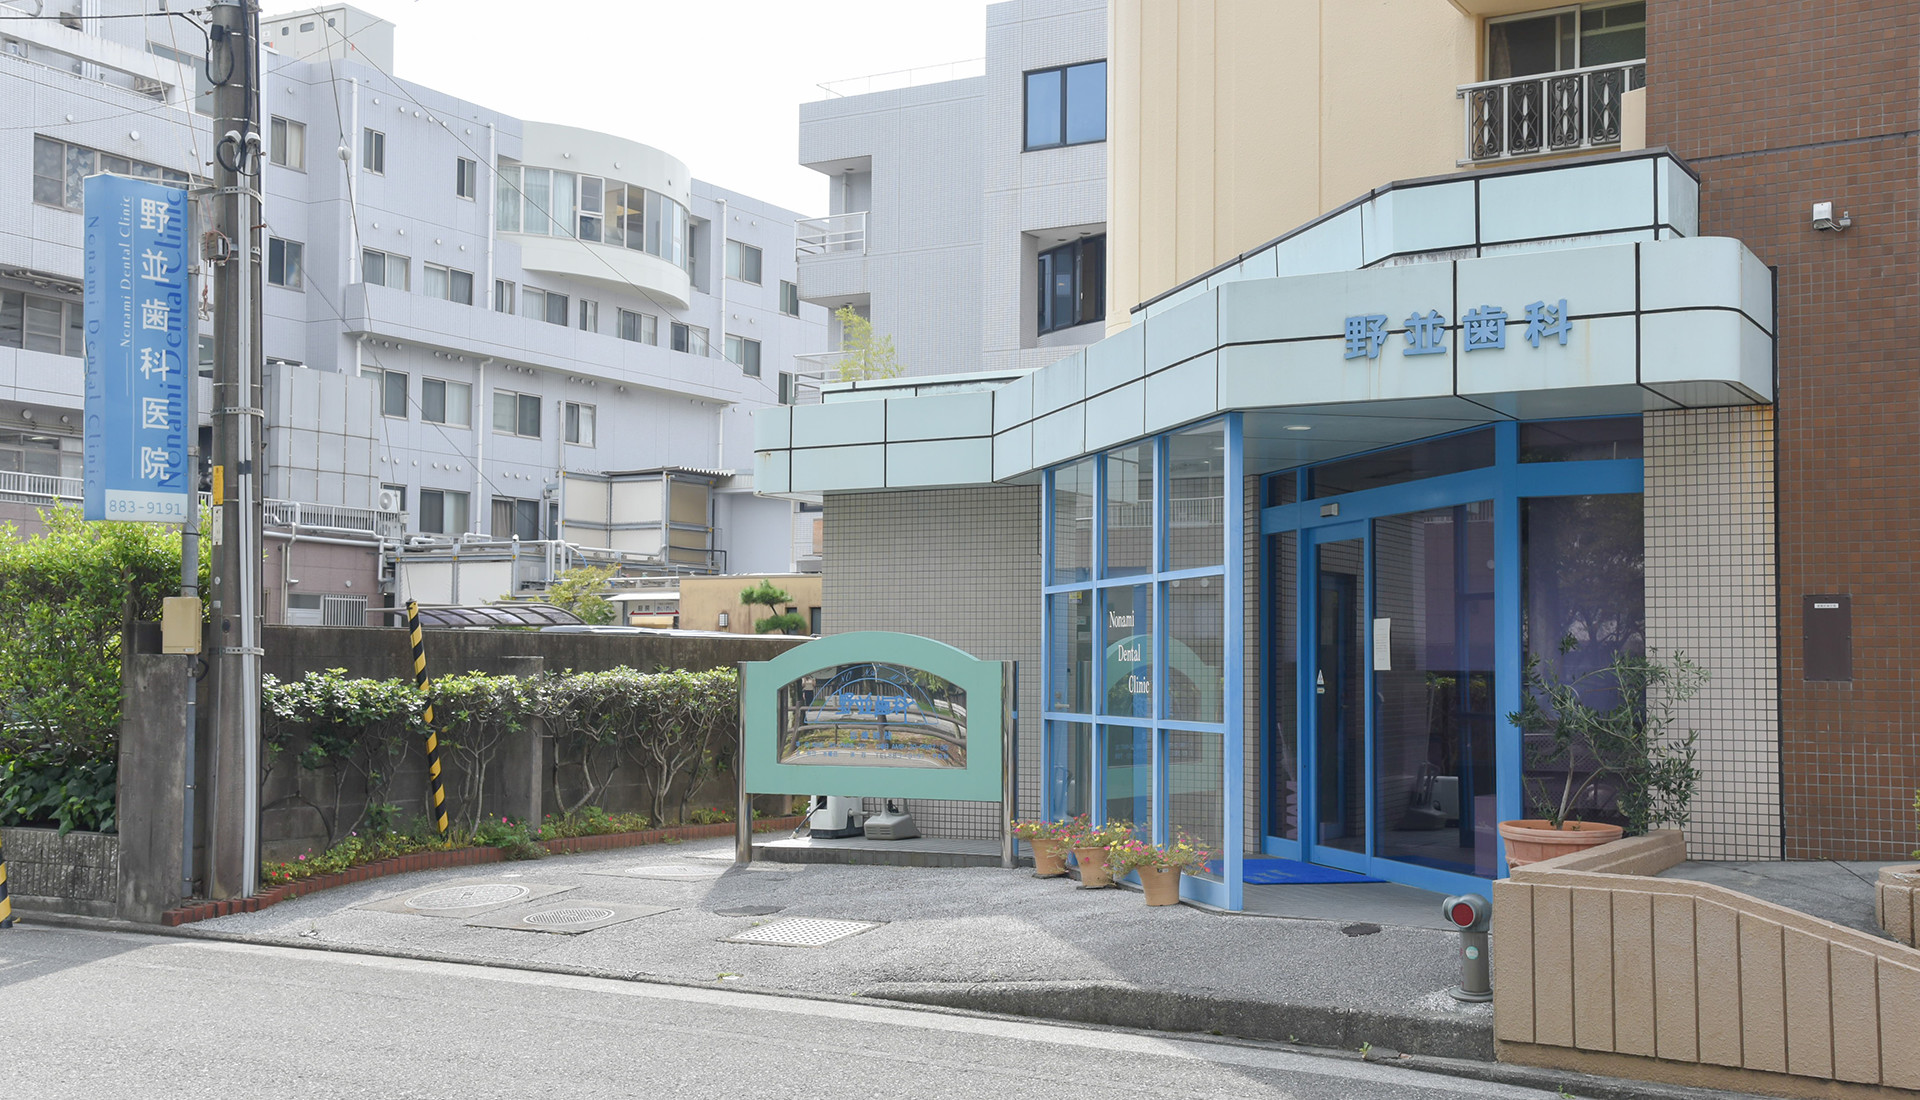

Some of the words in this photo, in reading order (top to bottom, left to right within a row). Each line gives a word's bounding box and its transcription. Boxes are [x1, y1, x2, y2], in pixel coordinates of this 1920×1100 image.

[118, 195, 131, 238] Clinic
[154, 190, 182, 274] Clinic
[88, 215, 100, 305] Nonami
[118, 242, 132, 290] Dental
[120, 295, 132, 348] Nonami
[140, 198, 171, 481] 野並歯科医院
[155, 281, 182, 375] Dental
[1344, 299, 1572, 360] 野並歯科
[88, 319, 101, 400] Dental
[88, 414, 101, 489] Clinic
[158, 384, 182, 488] Nonami
[109, 499, 183, 517] 883-9191
[1109, 610, 1135, 628] Nonami
[1118, 644, 1141, 662] Dental
[1128, 675, 1150, 694] Clinic
